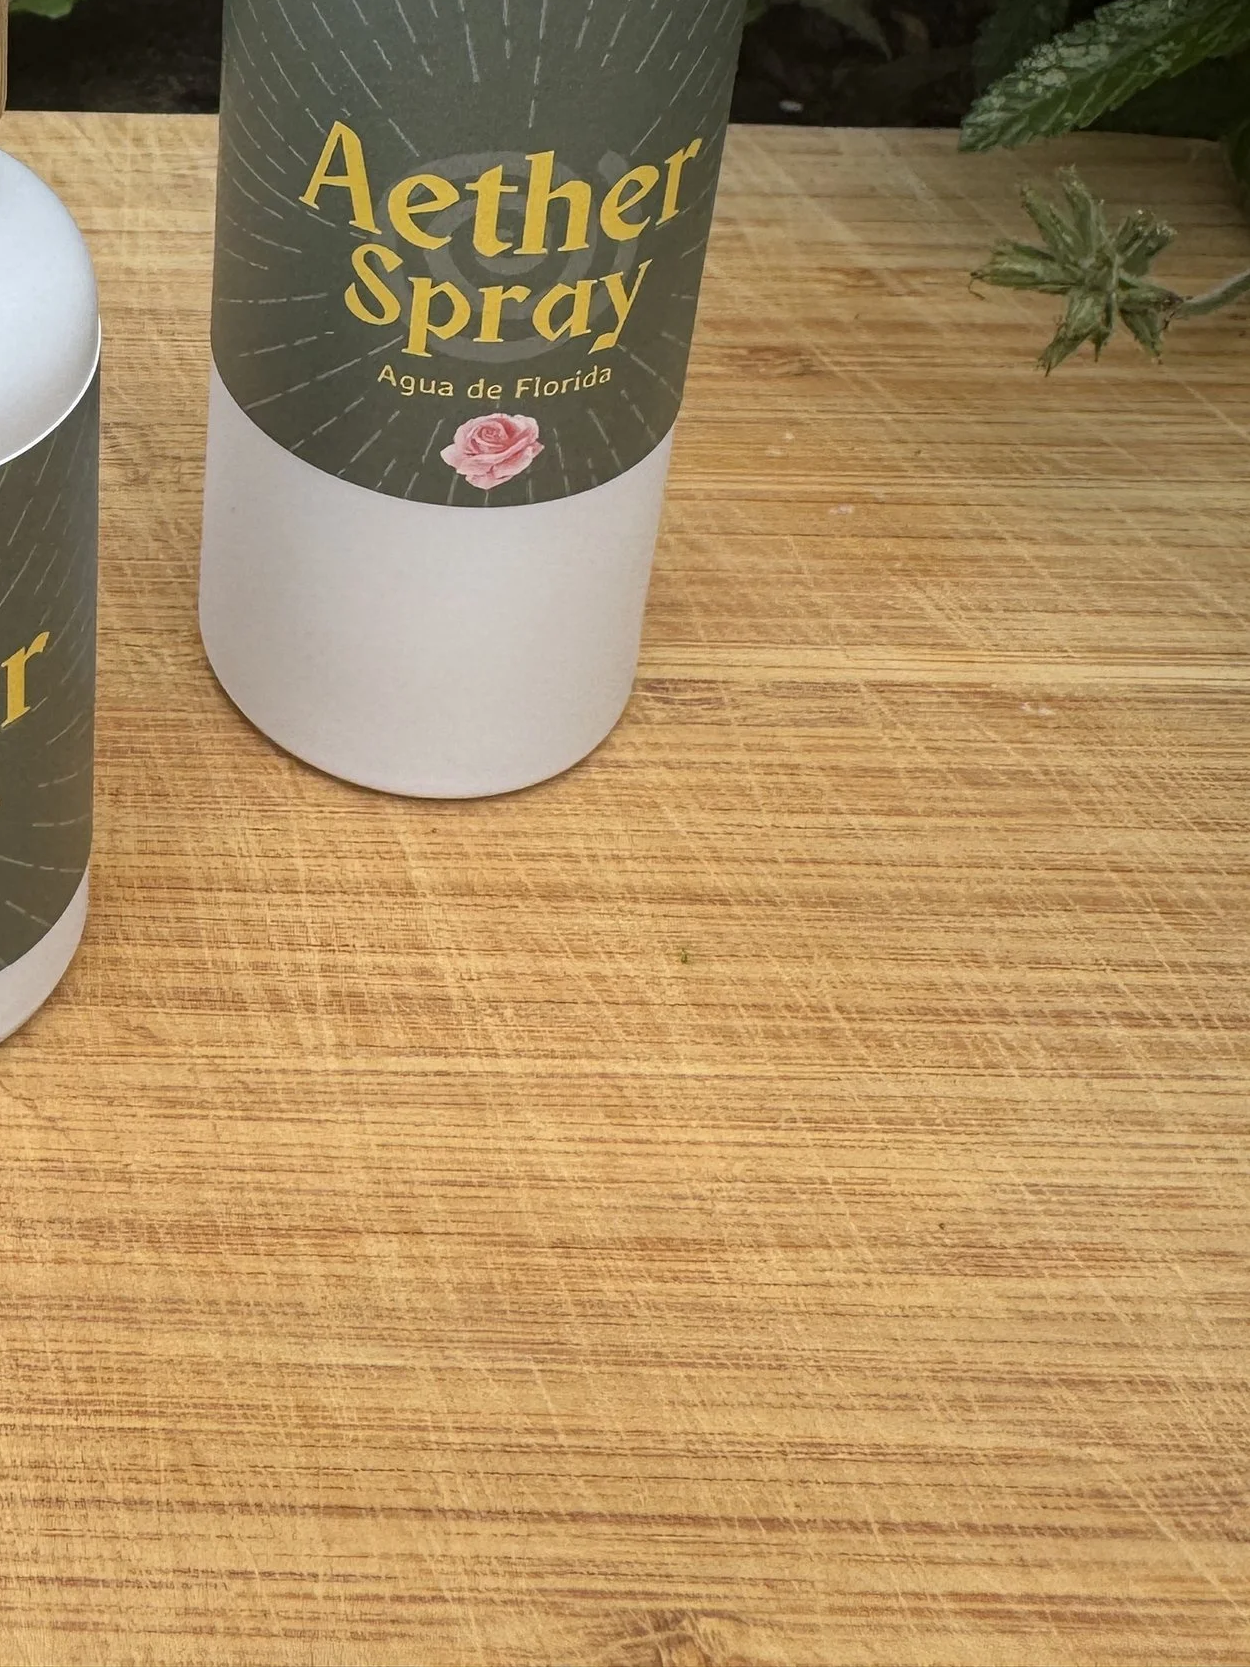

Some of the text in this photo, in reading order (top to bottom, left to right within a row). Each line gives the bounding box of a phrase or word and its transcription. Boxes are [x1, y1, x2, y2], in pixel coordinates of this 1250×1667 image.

[298, 120, 704, 259] Aether
[343, 242, 654, 358] Spray
[377, 364, 613, 401] Agua de Florida
